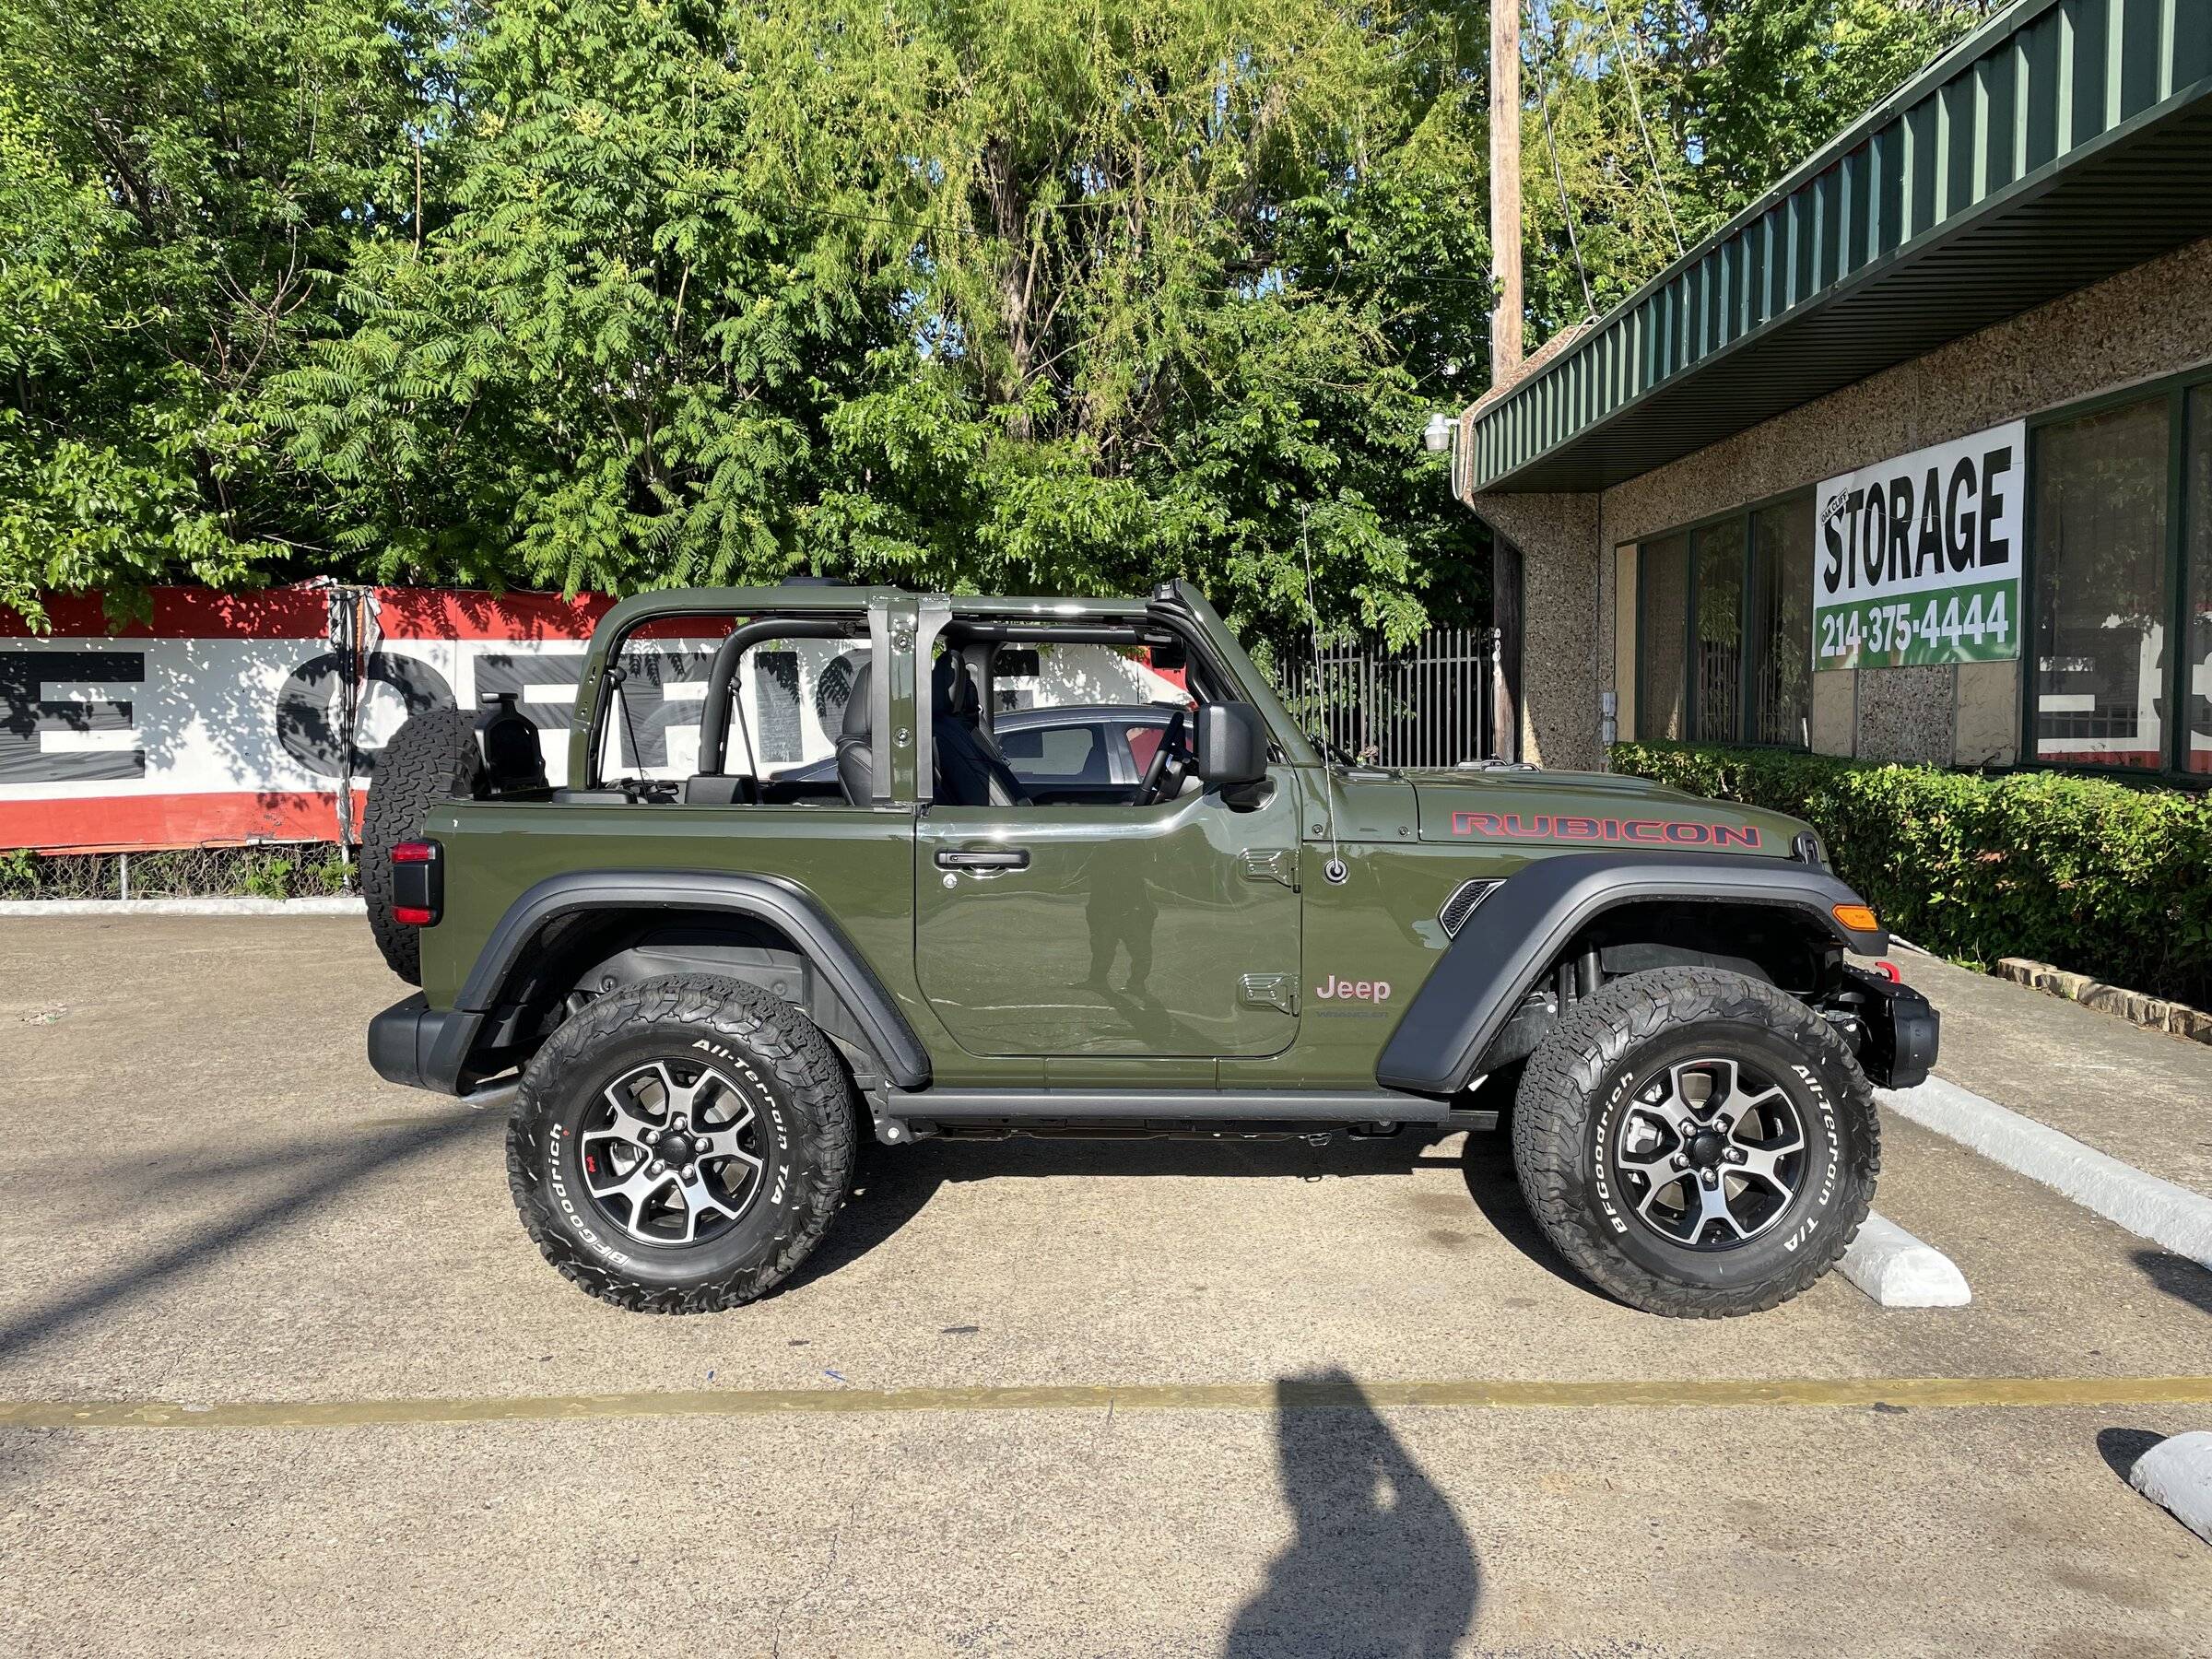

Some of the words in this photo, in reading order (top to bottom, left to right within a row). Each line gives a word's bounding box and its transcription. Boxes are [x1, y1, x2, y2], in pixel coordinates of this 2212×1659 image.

[1821, 508, 1832, 523] OAK
[1823, 446, 2012, 594] STORAGE
[1452, 811, 1762, 848] RUBICON
[1316, 973, 1391, 1005] Jeep
[692, 1039, 788, 1150] All-Terrain
[1595, 1071, 1633, 1234] BFGoodrich
[1791, 1065, 1839, 1206] All-Terrain
[548, 1123, 630, 1265] BFGoodrich
